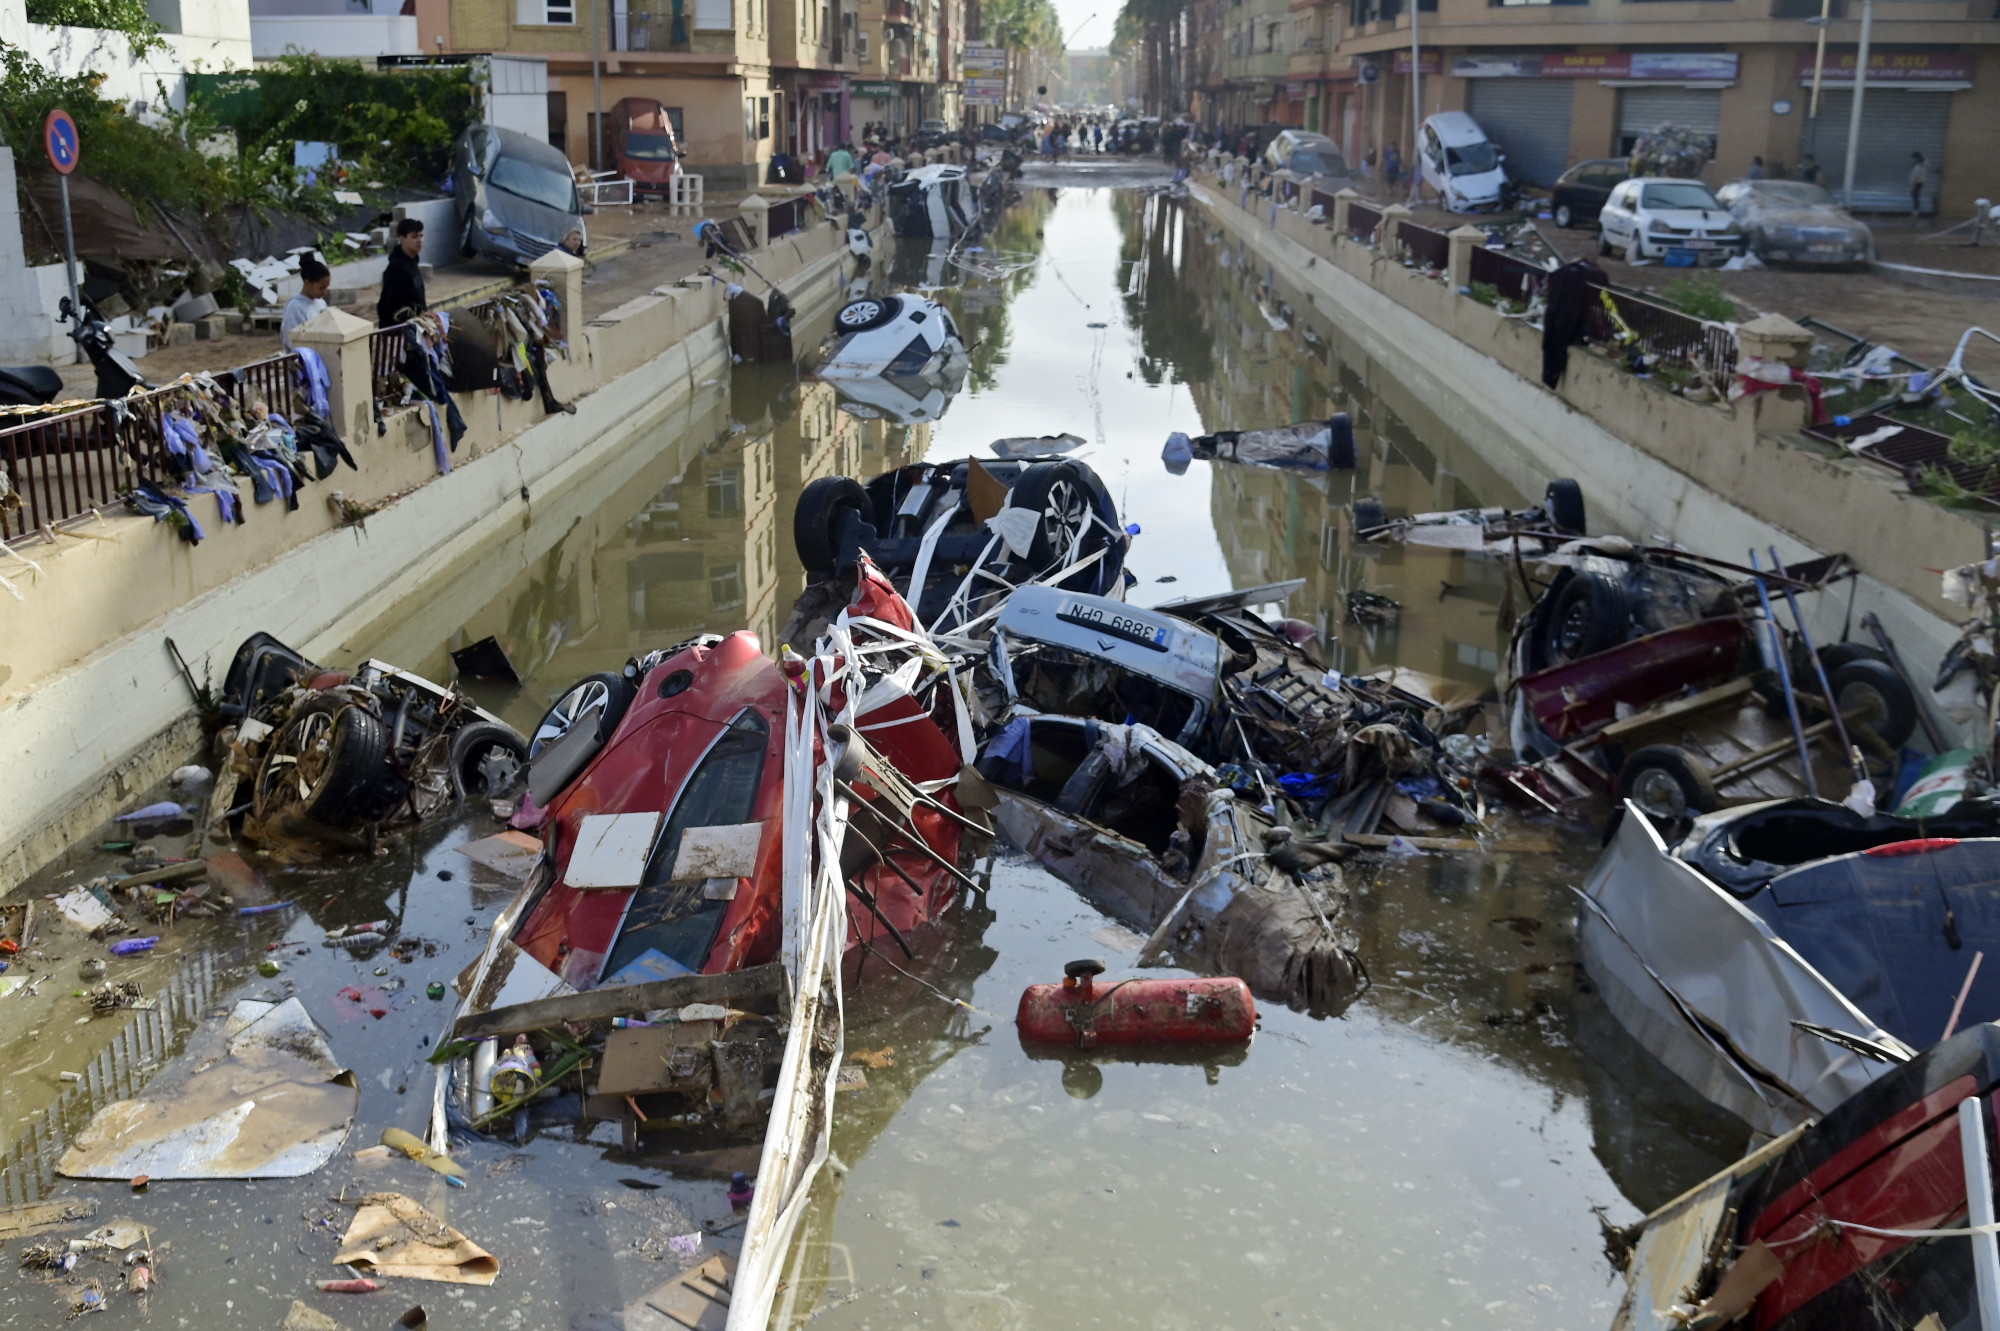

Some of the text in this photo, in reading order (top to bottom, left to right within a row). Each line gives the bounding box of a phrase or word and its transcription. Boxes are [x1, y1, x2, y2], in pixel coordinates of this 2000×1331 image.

[1840, 55, 1885, 67] BR
[1070, 604, 1154, 640] 3889 GPN
